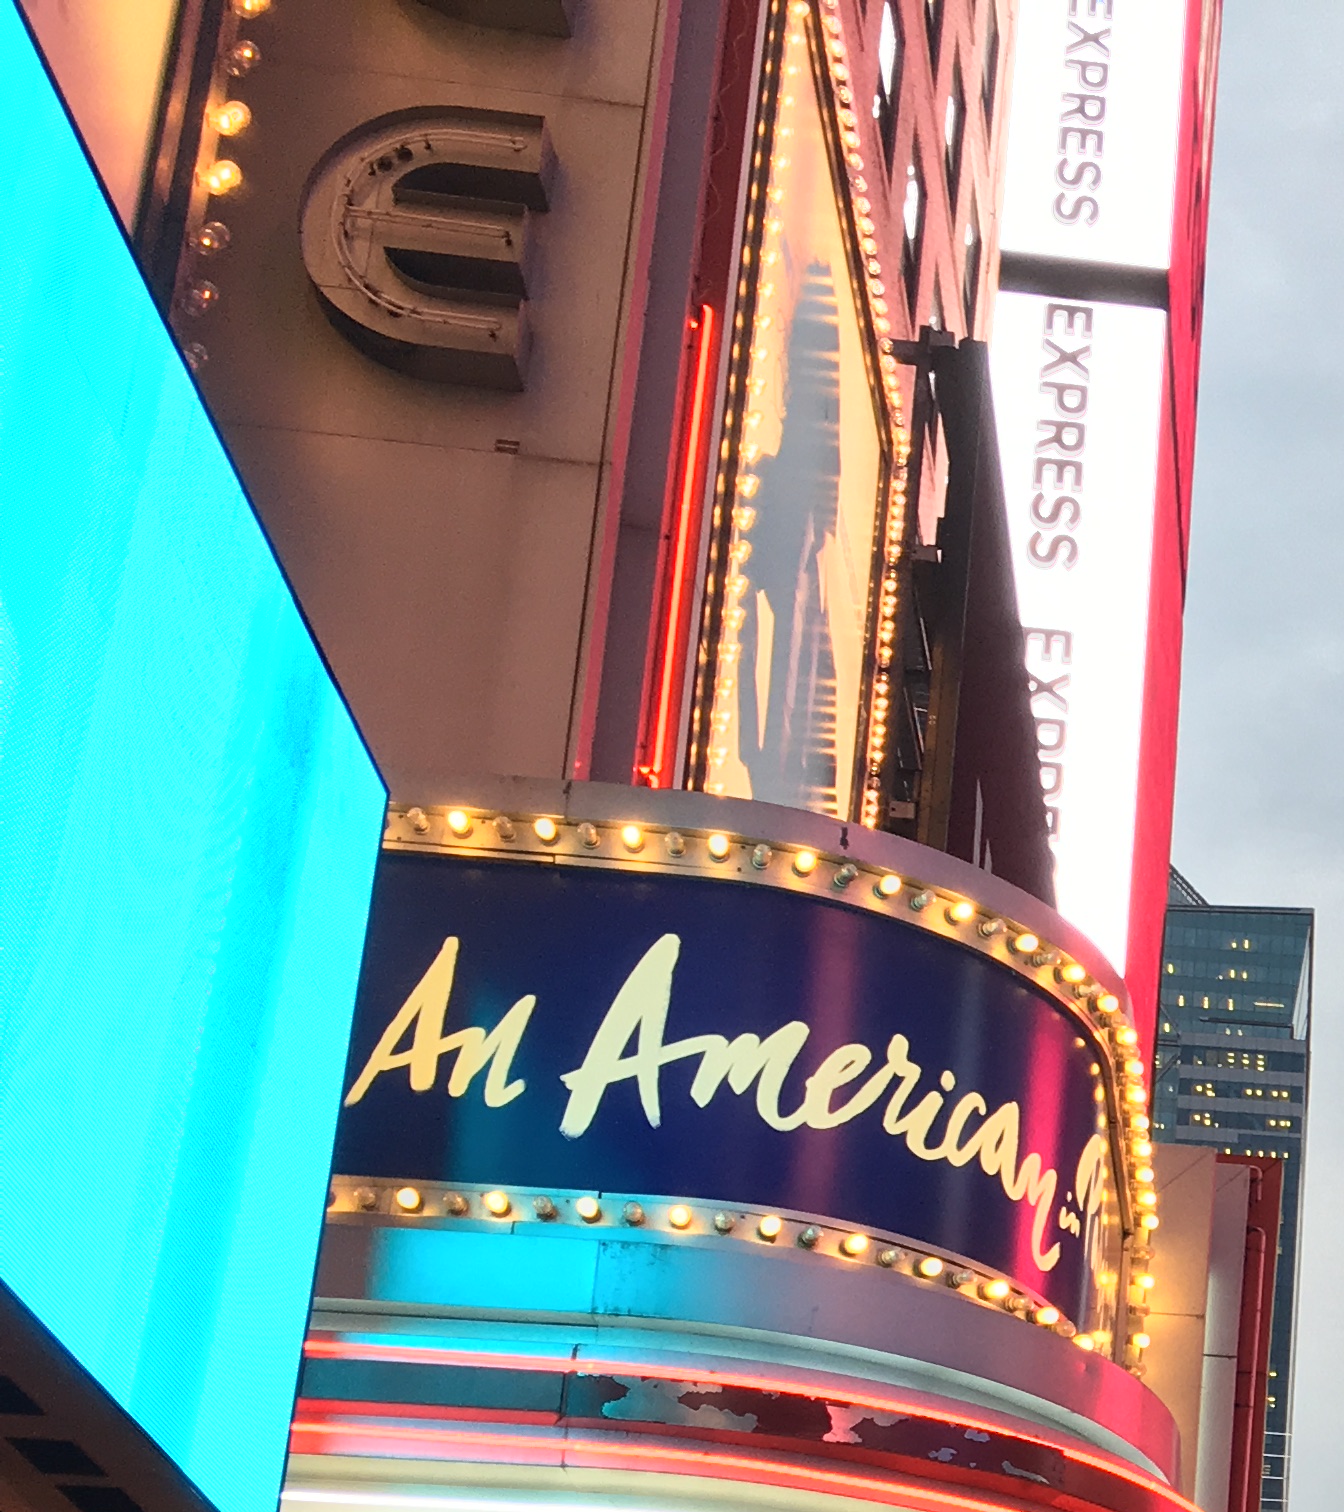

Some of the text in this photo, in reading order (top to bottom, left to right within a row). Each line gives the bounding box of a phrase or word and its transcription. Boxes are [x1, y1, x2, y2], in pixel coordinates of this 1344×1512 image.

[1026, 302, 1094, 571] EXPRESS
[344, 936, 537, 1109] An
[559, 934, 1060, 1272] American
